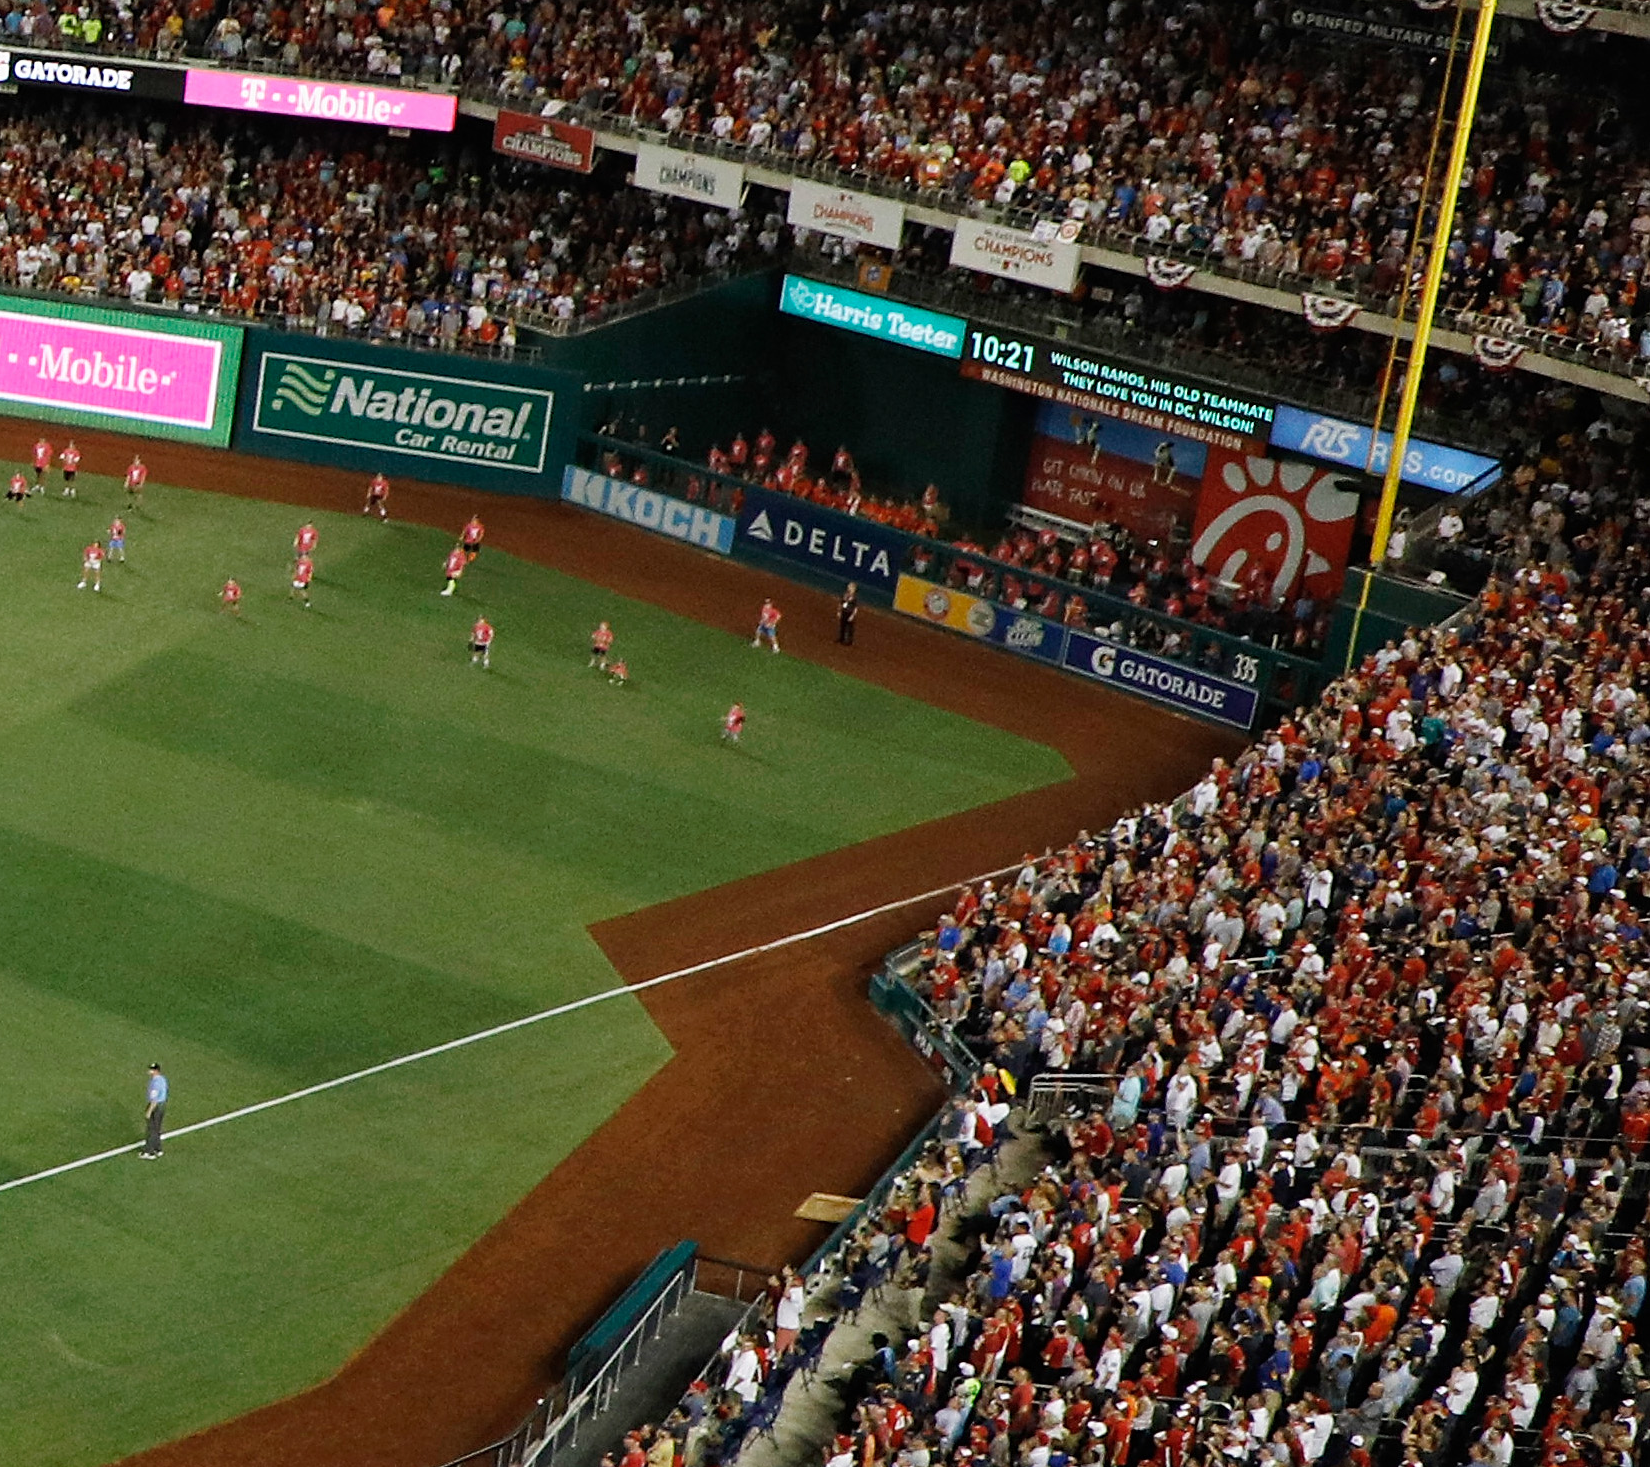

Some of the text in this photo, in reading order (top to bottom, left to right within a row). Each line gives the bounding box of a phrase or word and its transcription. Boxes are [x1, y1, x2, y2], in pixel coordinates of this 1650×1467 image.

[15, 58, 133, 91] GATORADE
[973, 235, 1054, 267] CHAMPIONS
[812, 292, 959, 350] Harris Teeter
[970, 331, 1035, 373] 10:21
[331, 373, 533, 440] National
[979, 367, 1244, 452] WASHINGTON NATIONALS FOUNDATION
[1050, 351, 1274, 423] WILSON RAMOS, HIS OLD TEAMMATE
[1062, 371, 1255, 435] THEY LOVE YOU WILSON!
[393, 427, 517, 463] Car Rental
[608, 479, 722, 549] KOCH
[783, 519, 890, 578] DELTA
[1119, 658, 1228, 710] GATORADE
[1231, 652, 1261, 684] 335
